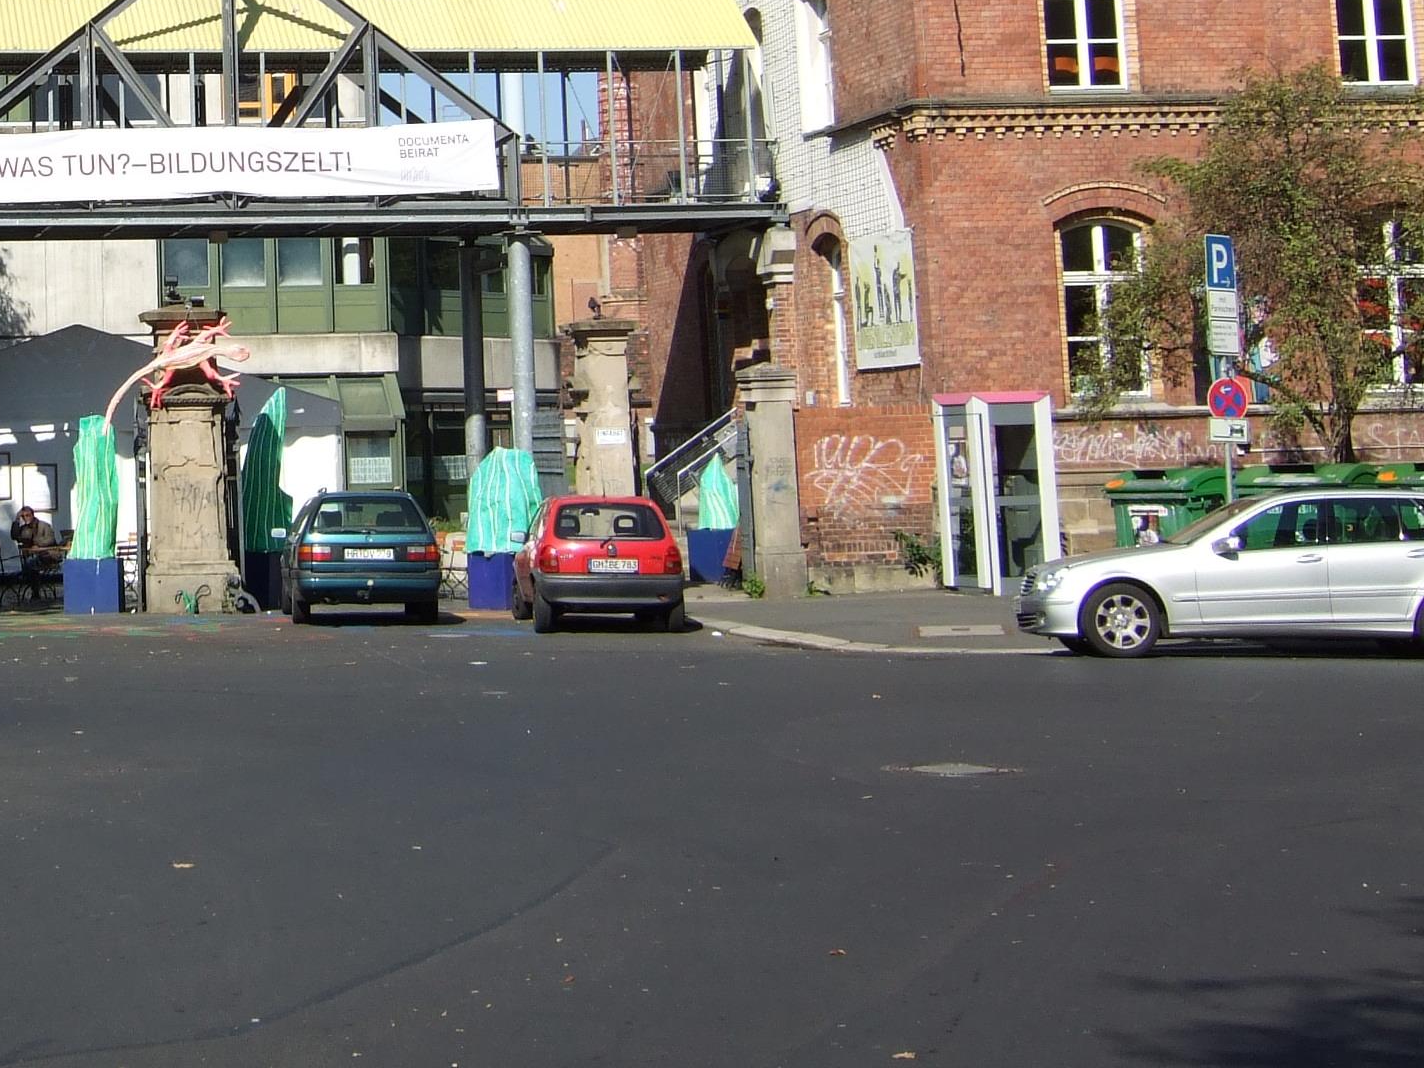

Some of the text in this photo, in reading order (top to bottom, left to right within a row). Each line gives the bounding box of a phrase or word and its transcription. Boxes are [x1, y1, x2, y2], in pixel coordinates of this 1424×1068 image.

[398, 134, 469, 147] DOCUMENTA
[399, 147, 440, 158] BEIRAT
[1211, 243, 1228, 284] P
